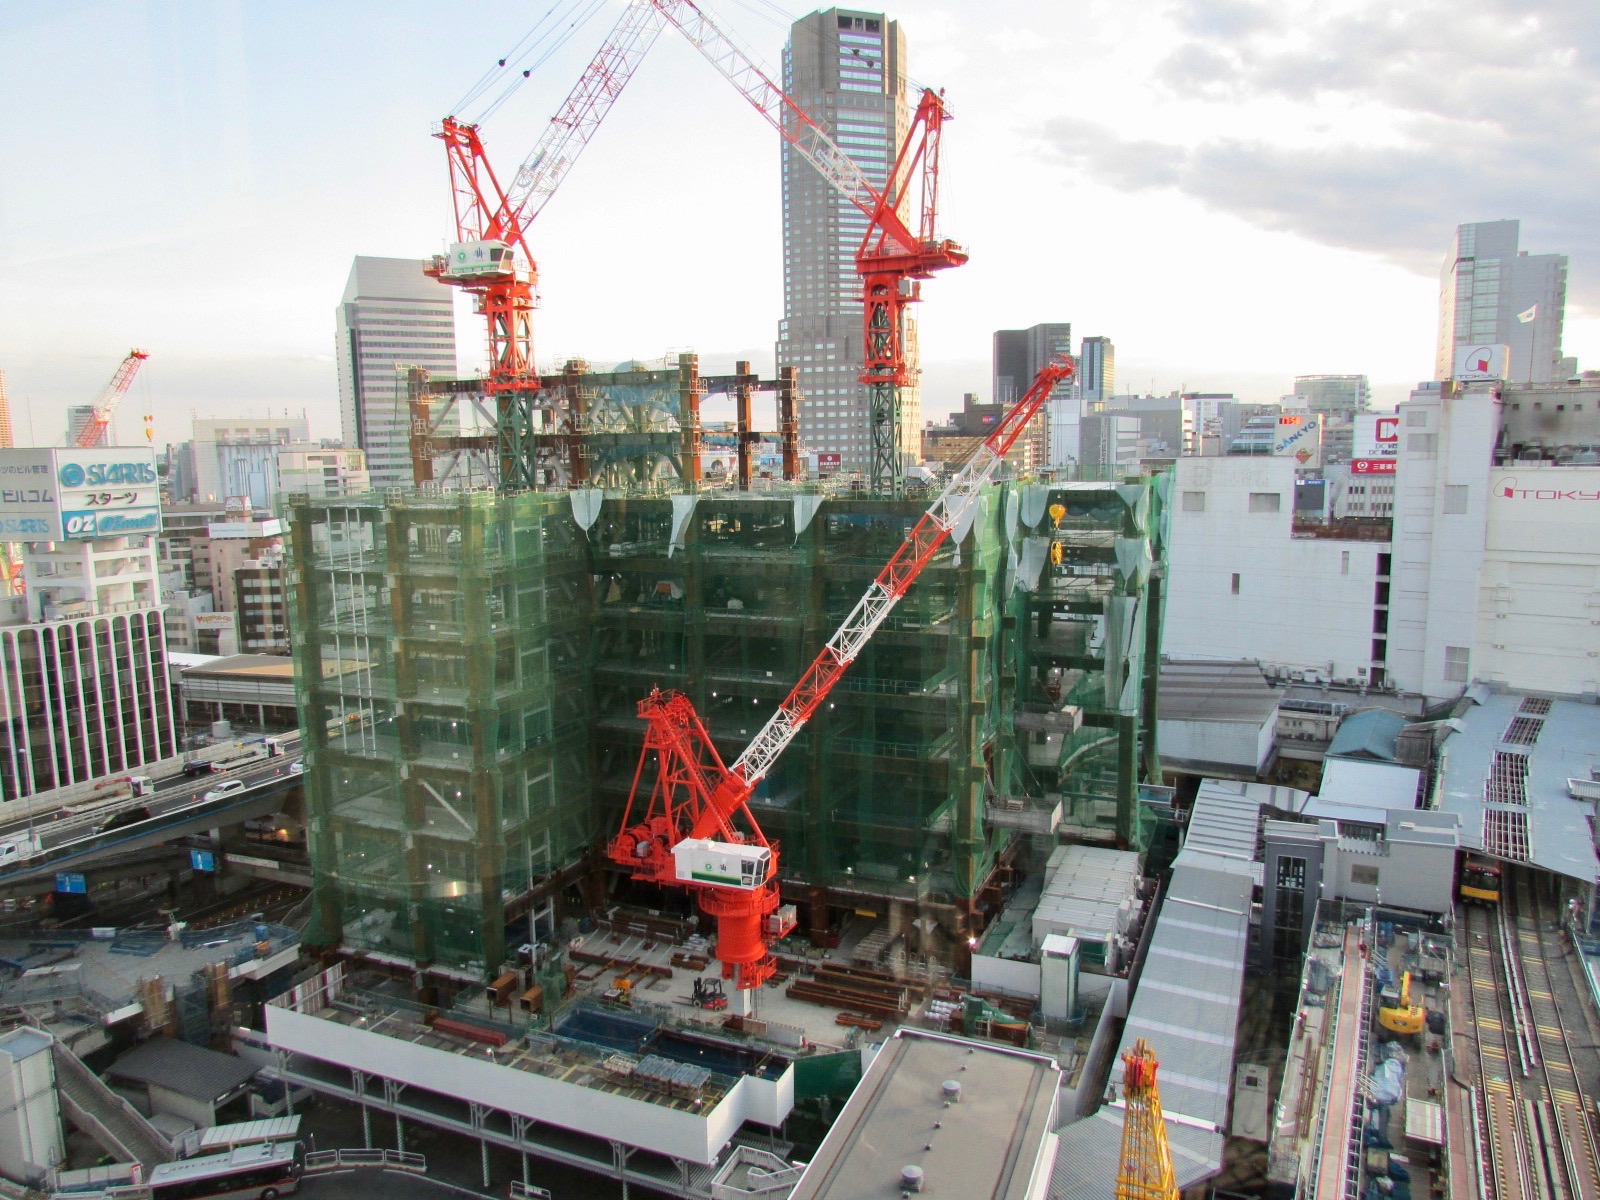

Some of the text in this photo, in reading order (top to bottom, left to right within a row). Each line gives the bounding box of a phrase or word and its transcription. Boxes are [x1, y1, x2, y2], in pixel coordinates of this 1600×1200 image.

[1275, 421, 1317, 452] SANKYO
[0, 464, 48, 474] ツのビル管理
[86, 463, 156, 485] STARTS
[2, 489, 54, 503] ビルコム
[85, 491, 138, 506] スターツ
[6, 518, 49, 533] STARTS
[67, 515, 95, 533] OZ
